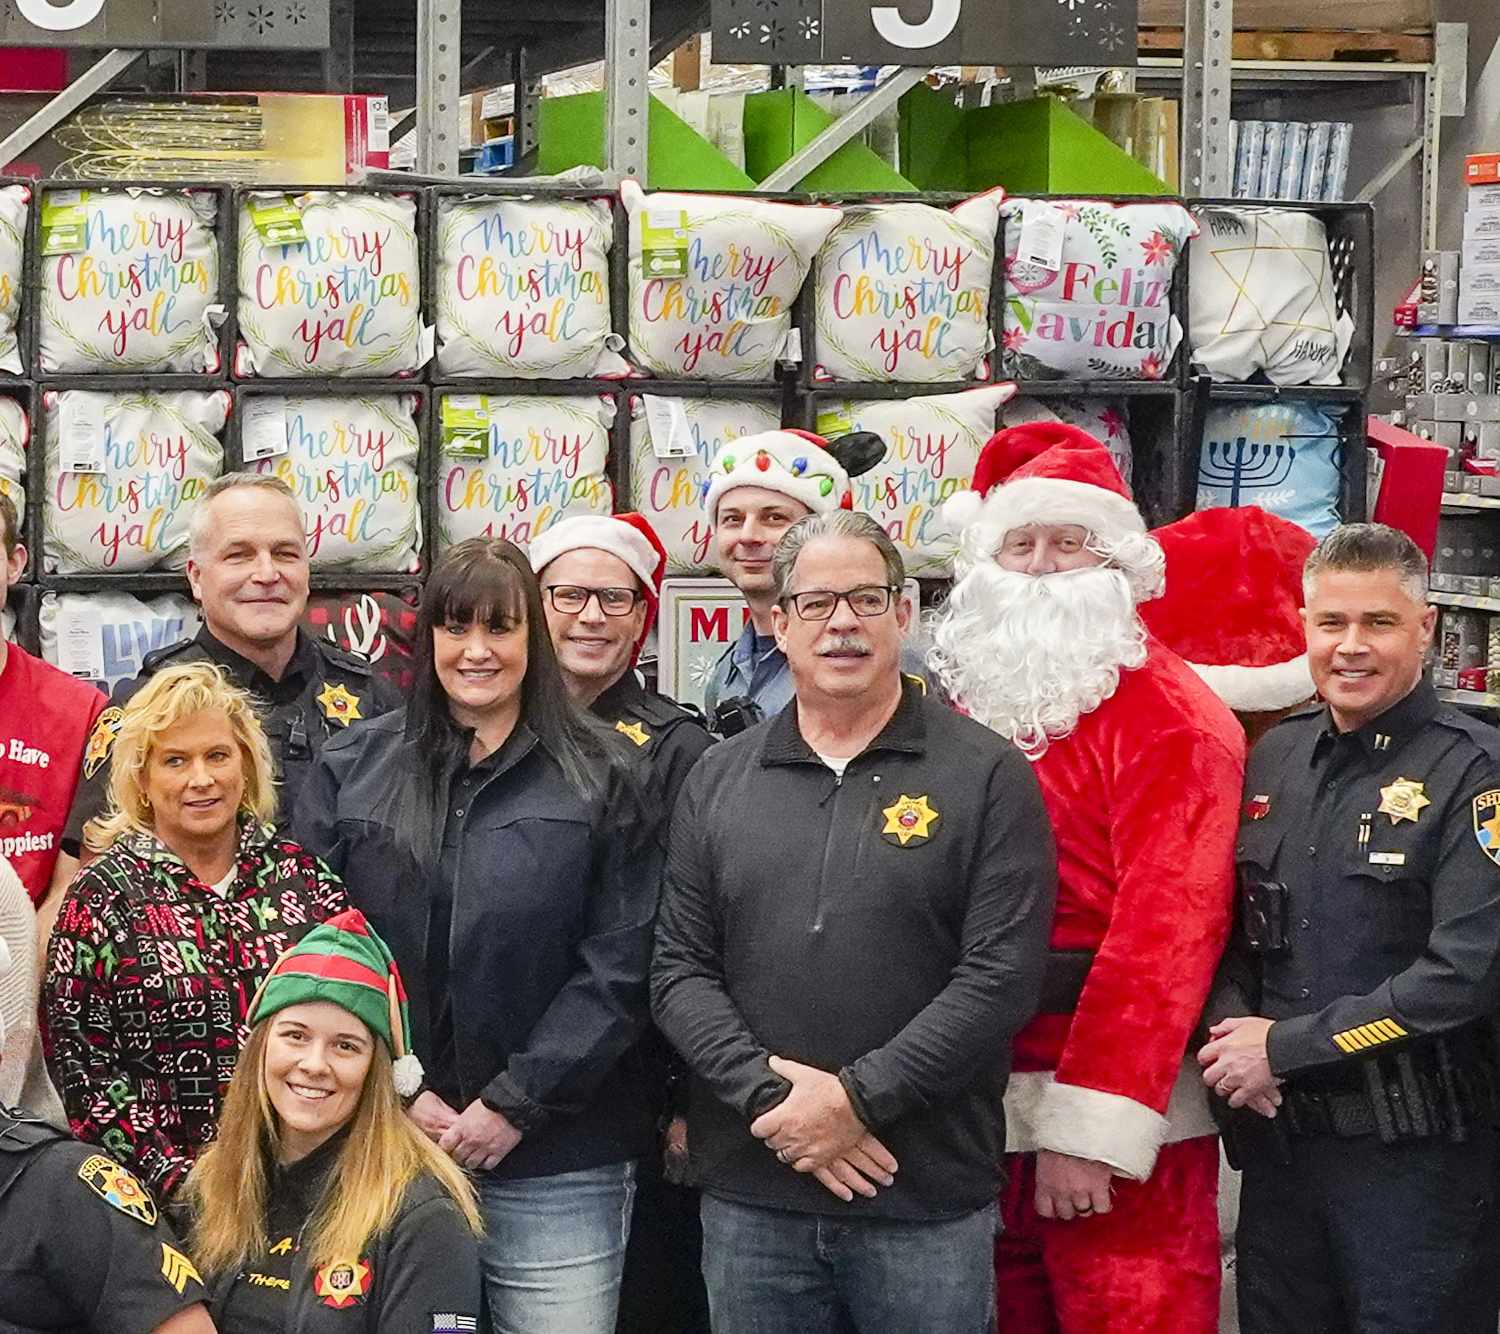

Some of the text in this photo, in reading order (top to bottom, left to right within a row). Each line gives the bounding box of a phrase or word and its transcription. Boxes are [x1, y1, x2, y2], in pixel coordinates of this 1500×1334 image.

[460, 212, 594, 271] Merry
[1208, 217, 1247, 238] HAPPY
[56, 252, 208, 302] Christmas
[456, 254, 604, 306] Christmas
[838, 230, 974, 291] Merry
[1059, 261, 1163, 309] Feliz
[255, 264, 411, 311] Christmas
[642, 278, 781, 324] Christmas
[832, 272, 984, 323] Christmas
[97, 291, 192, 357] y'all
[292, 304, 391, 365] y'all
[494, 298, 589, 358] y'all
[673, 319, 764, 373] y'all
[870, 315, 967, 373] y'all
[445, 466, 604, 514] Christmas
[90, 509, 189, 567] y'all
[9, 739, 51, 769] Have
